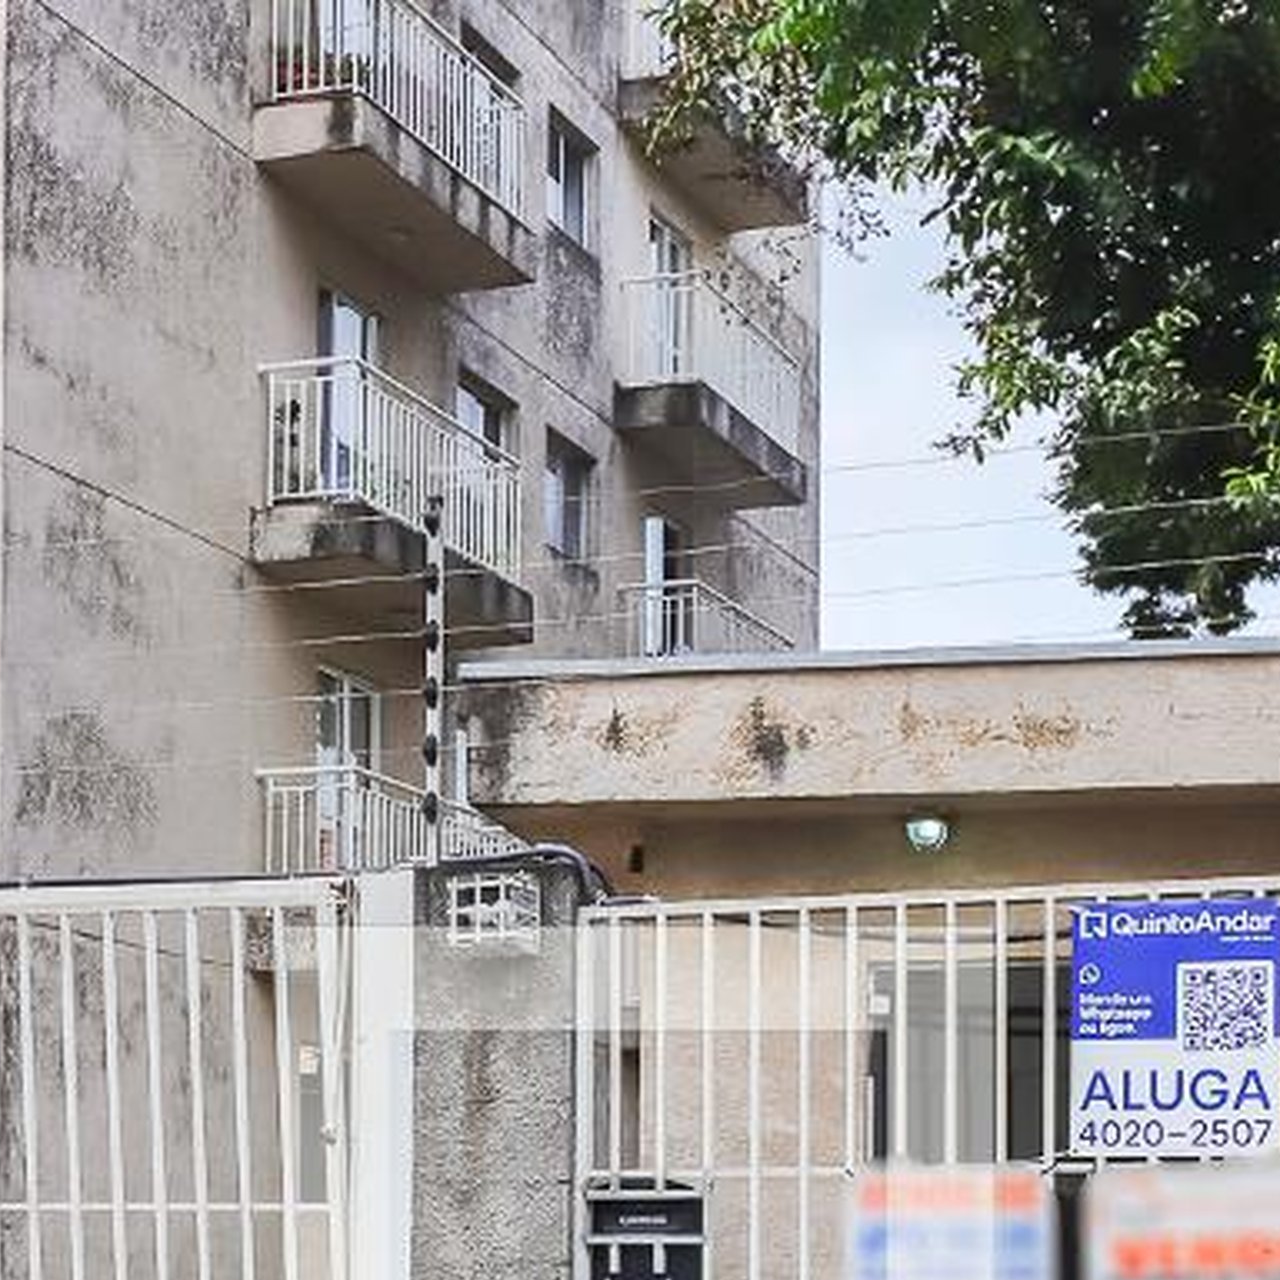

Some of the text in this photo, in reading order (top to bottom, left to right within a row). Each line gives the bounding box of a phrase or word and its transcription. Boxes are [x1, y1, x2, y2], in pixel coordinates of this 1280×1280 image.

[1111, 909, 1277, 936] QuintoAndar
[1079, 1068, 1272, 1112] ALUGA
[1078, 1118, 1273, 1148] 4020-2507
